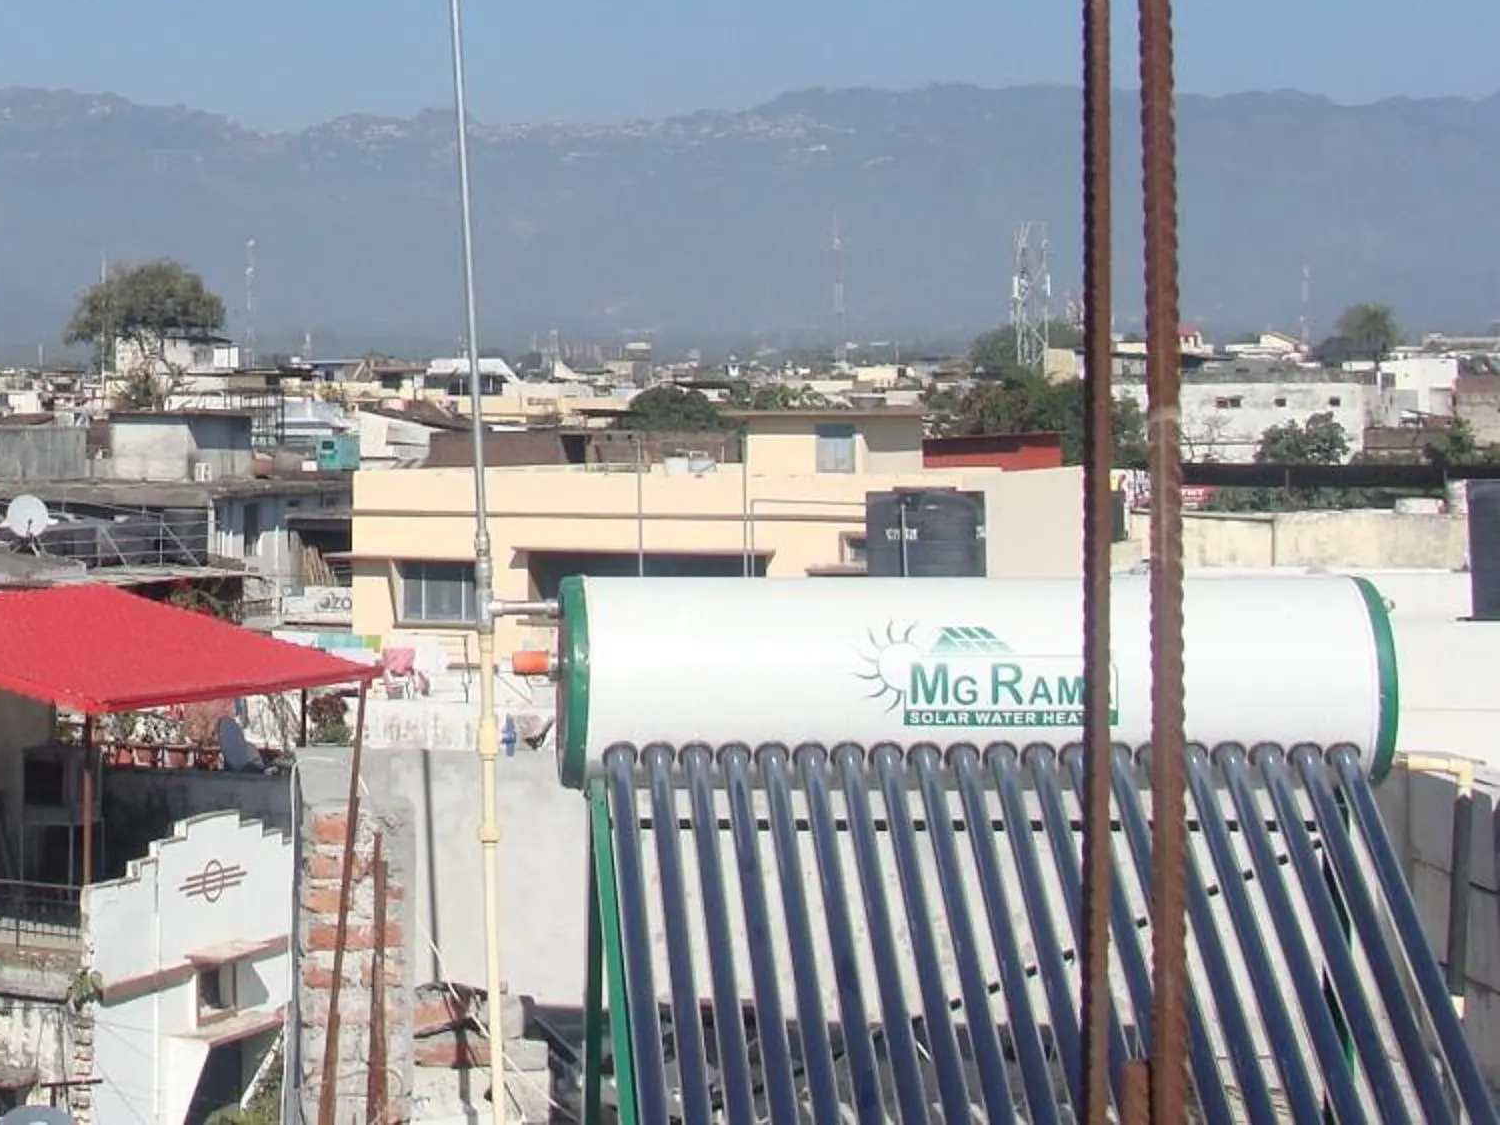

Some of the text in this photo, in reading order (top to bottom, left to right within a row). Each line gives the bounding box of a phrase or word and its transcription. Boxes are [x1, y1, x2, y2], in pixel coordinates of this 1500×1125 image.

[991, 662, 1111, 706] RAM
[909, 711, 1111, 724] SOLAR WATER HEA
